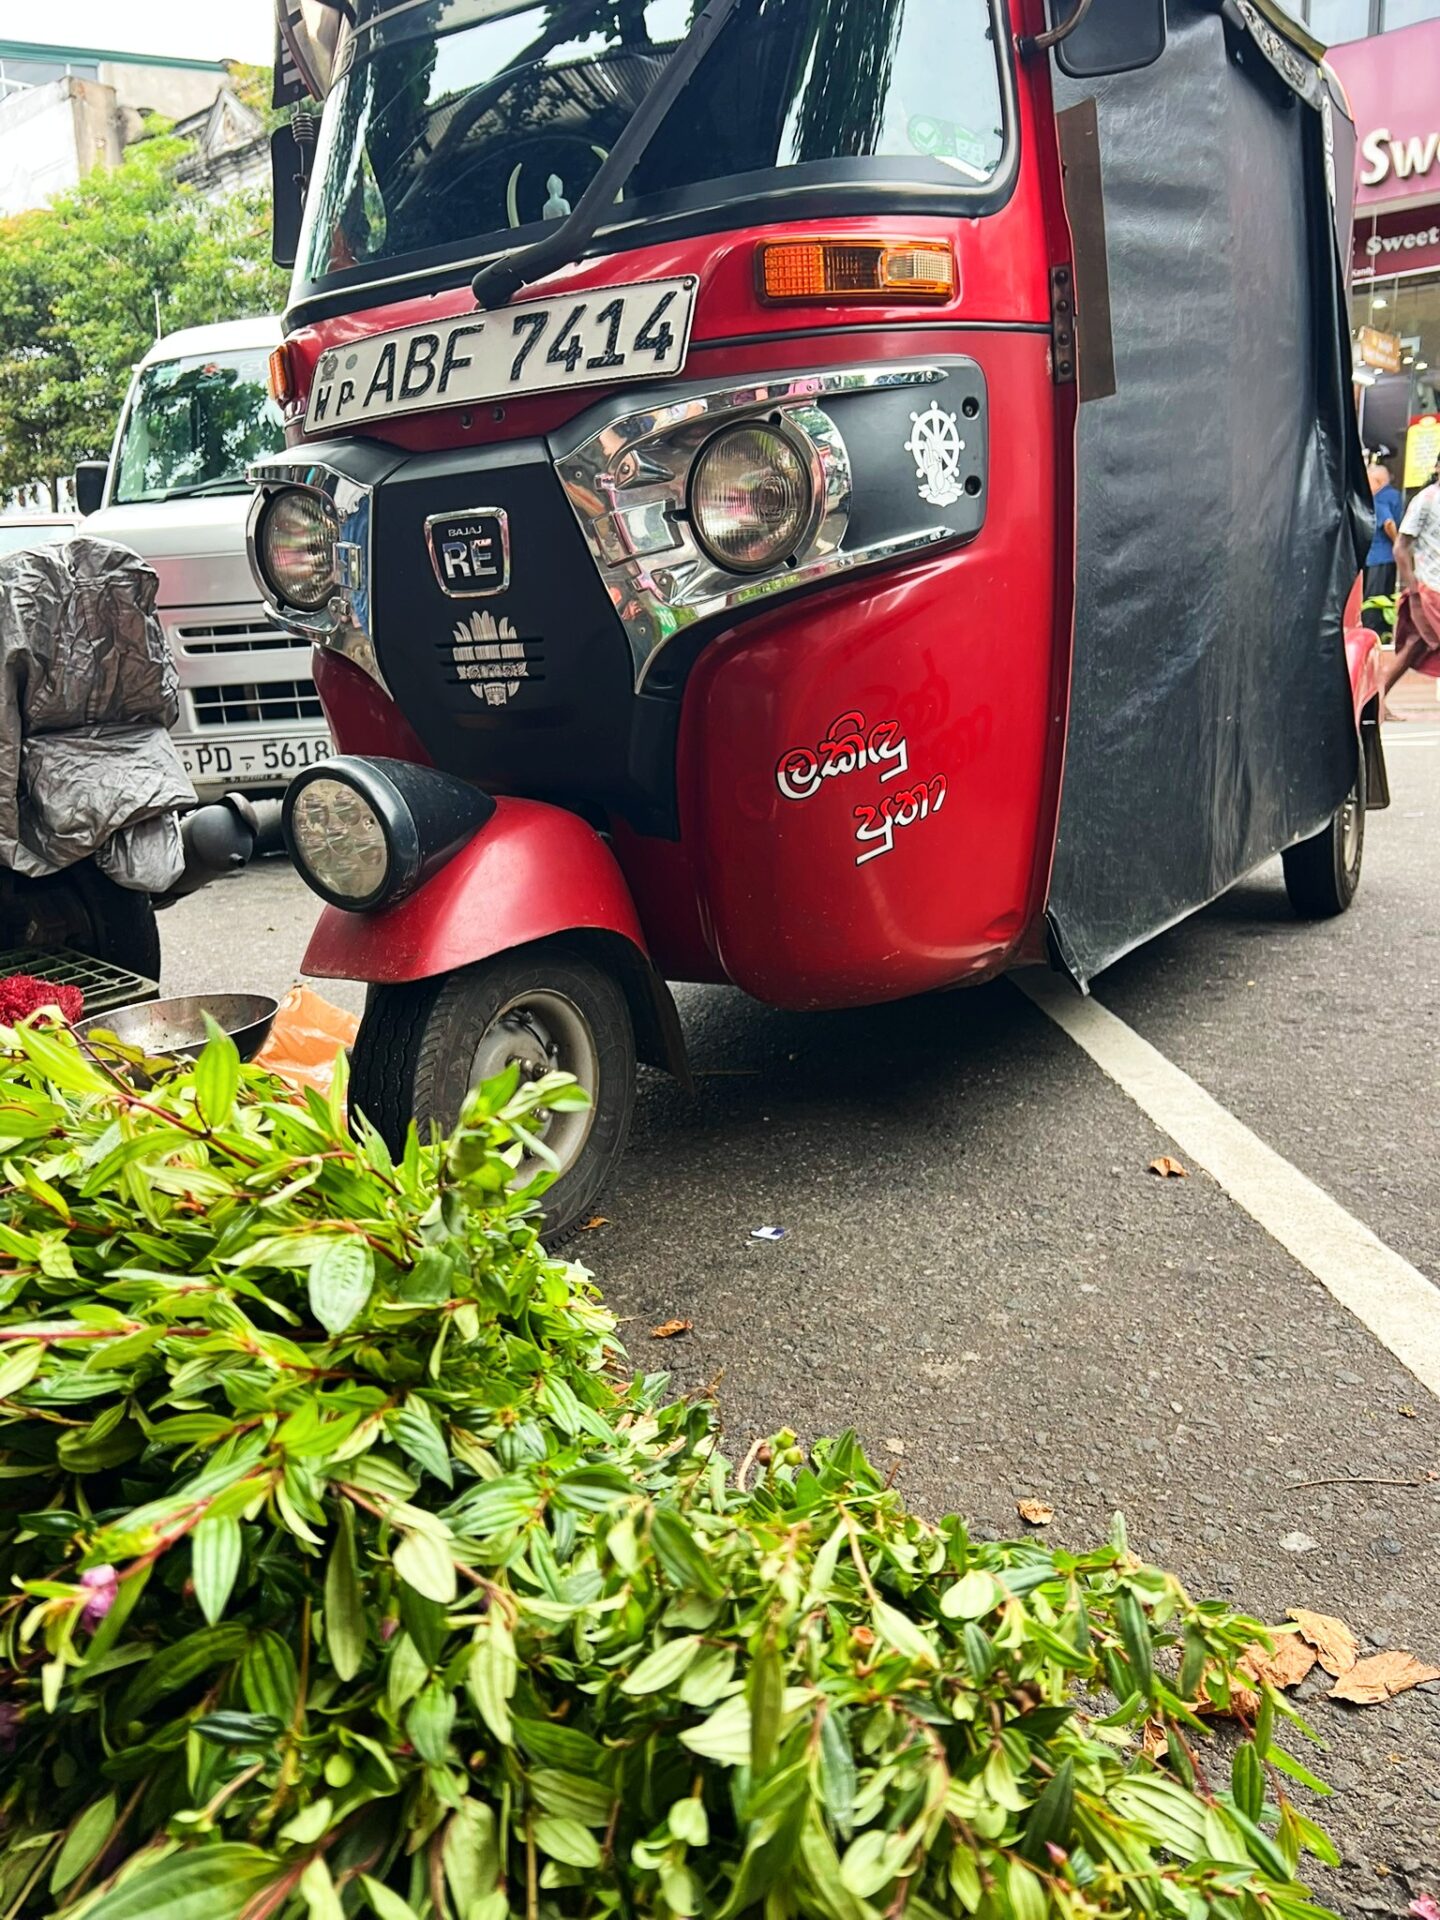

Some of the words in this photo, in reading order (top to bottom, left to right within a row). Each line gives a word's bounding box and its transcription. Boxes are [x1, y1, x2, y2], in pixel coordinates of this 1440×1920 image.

[1365, 226, 1440, 256] Sweet
[362, 320, 486, 408] ABF
[510, 290, 678, 382] 7414
[448, 525, 482, 537] BAJAJ
[442, 538, 498, 579] RE
[195, 746, 232, 774] PD
[262, 740, 330, 770] 5618
